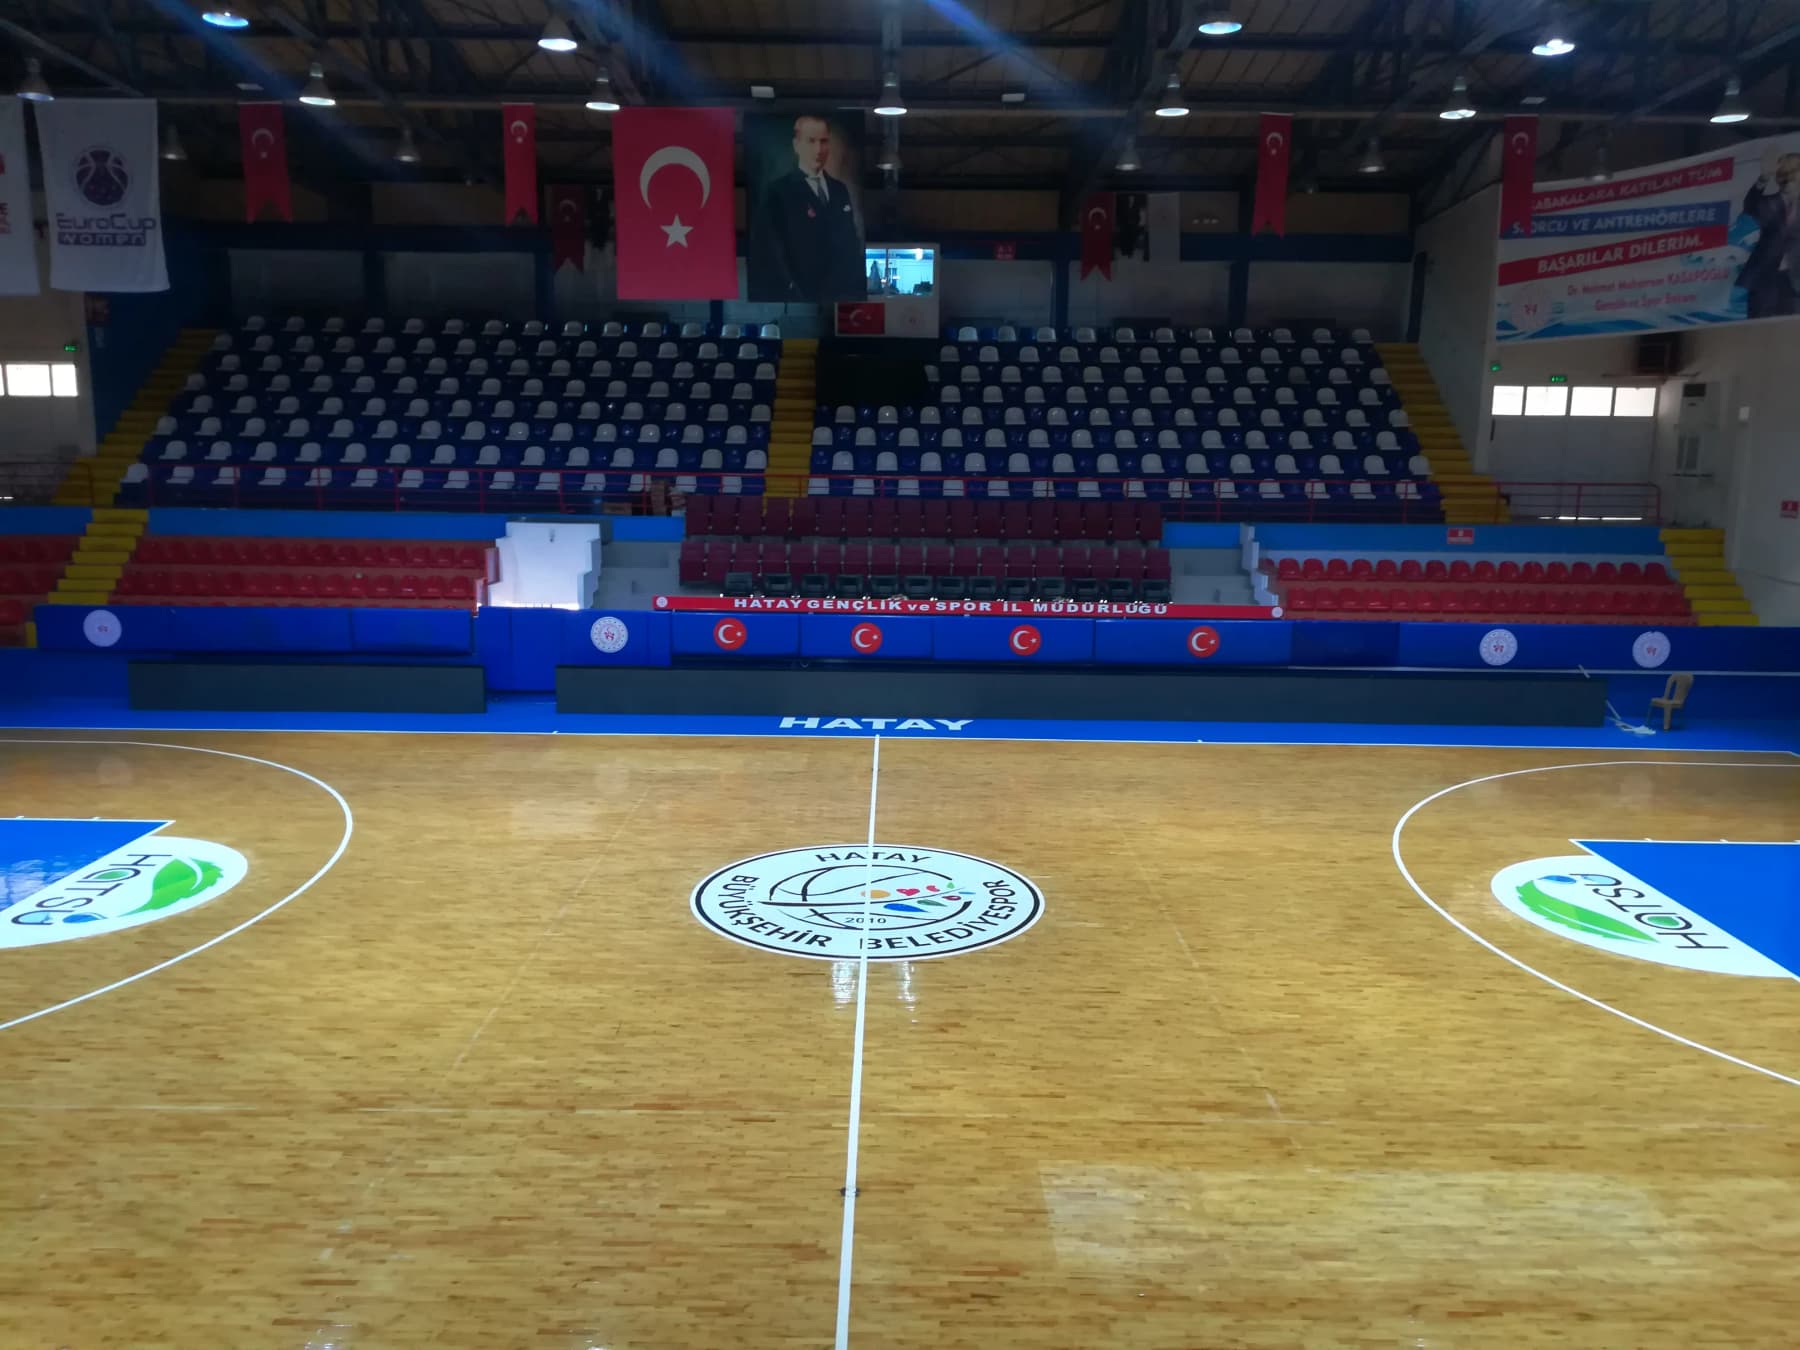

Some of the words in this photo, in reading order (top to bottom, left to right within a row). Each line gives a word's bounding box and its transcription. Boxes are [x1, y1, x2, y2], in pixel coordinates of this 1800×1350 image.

[56, 213, 157, 230] EuroCup
[1512, 218, 1567, 235] SORCU
[1572, 217, 1589, 232] VE
[1593, 207, 1717, 231] ANTRENÖRLERE
[1537, 244, 1624, 275] BAŞARILAR
[734, 598, 800, 610] HATAY
[807, 598, 902, 612] GENÇLİK
[907, 603, 930, 612] ve
[935, 600, 991, 612] SPOR
[1002, 600, 1023, 613] İL
[1032, 600, 1168, 615] MÜDÜRLÜĞÜ
[779, 717, 974, 731] HATAY
[815, 851, 932, 864] HATAY
[717, 874, 833, 949] BÜYÜKŞEHİR
[859, 878, 1016, 950] BELEDİYESPOR
[844, 916, 887, 925] 2010
